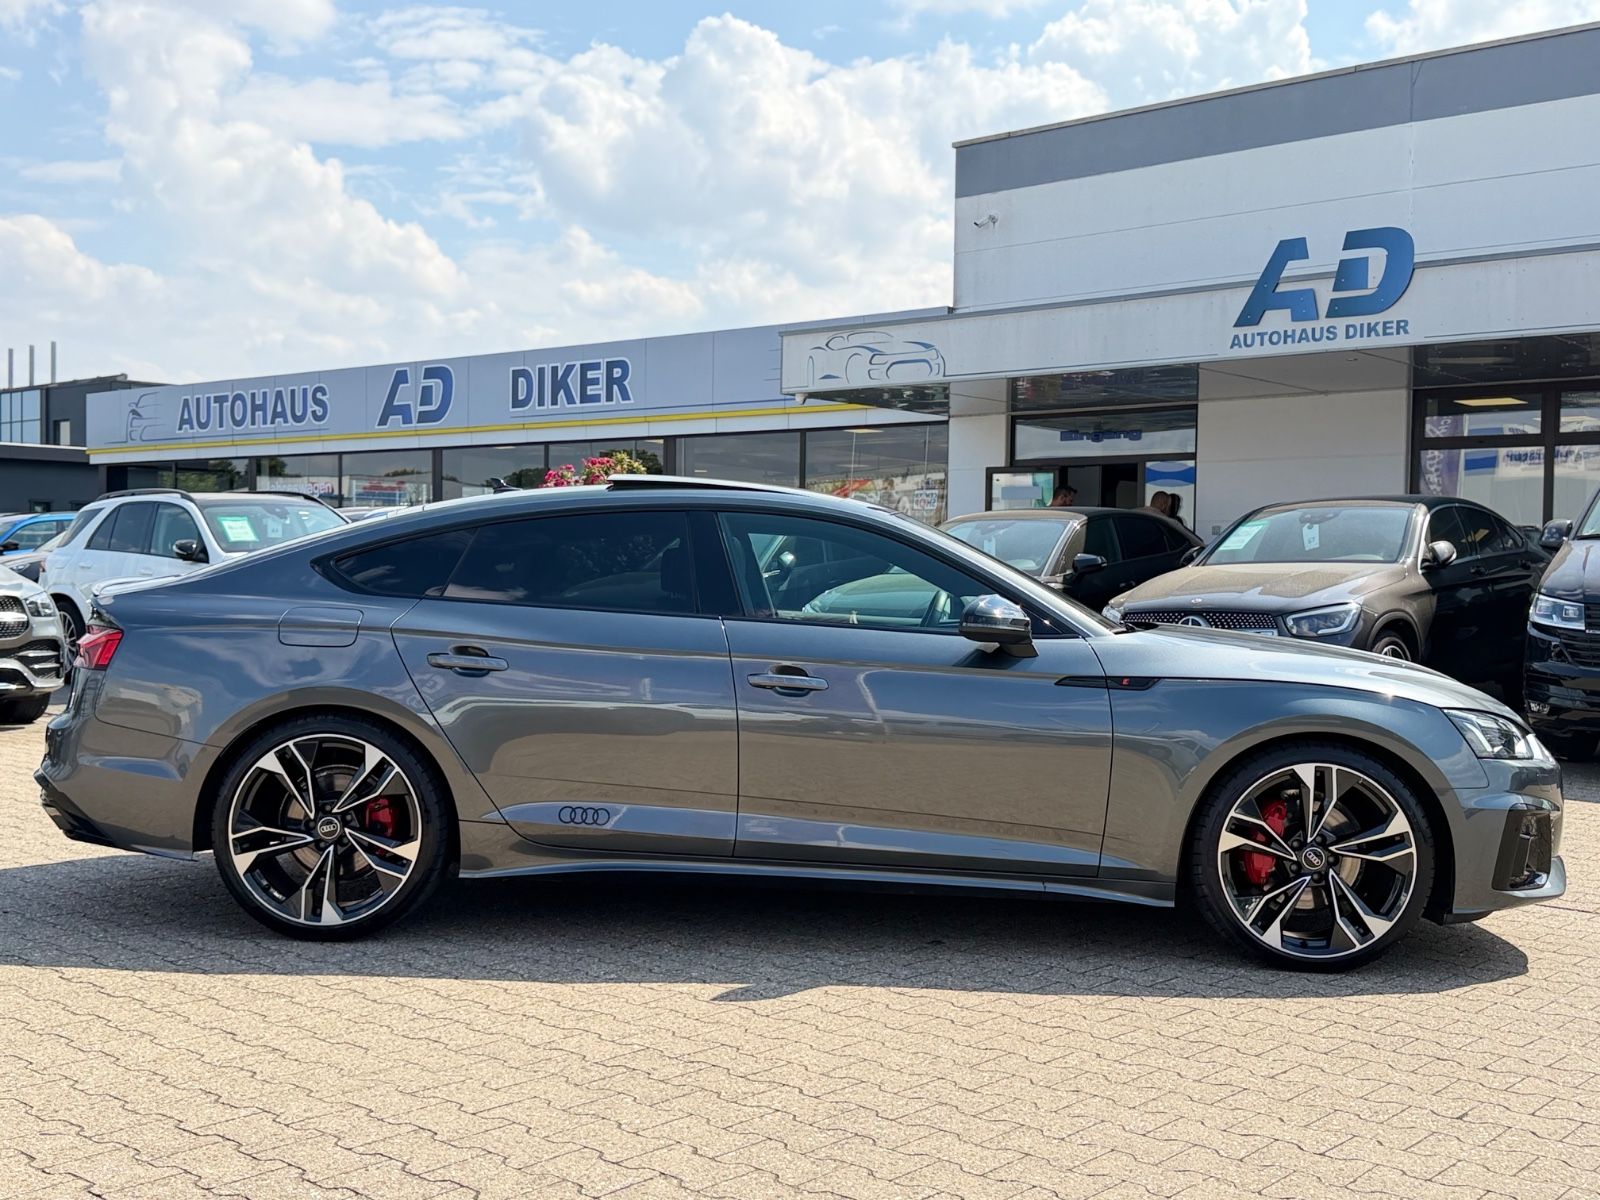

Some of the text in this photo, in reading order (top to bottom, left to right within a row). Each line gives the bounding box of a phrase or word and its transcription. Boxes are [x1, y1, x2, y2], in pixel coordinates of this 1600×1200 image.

[1230, 319, 1410, 350] AUTOHAUS DIKER
[177, 384, 330, 432] AUTOHAUS
[510, 358, 633, 411] DIKER
[1060, 429, 1142, 443] Eingang
